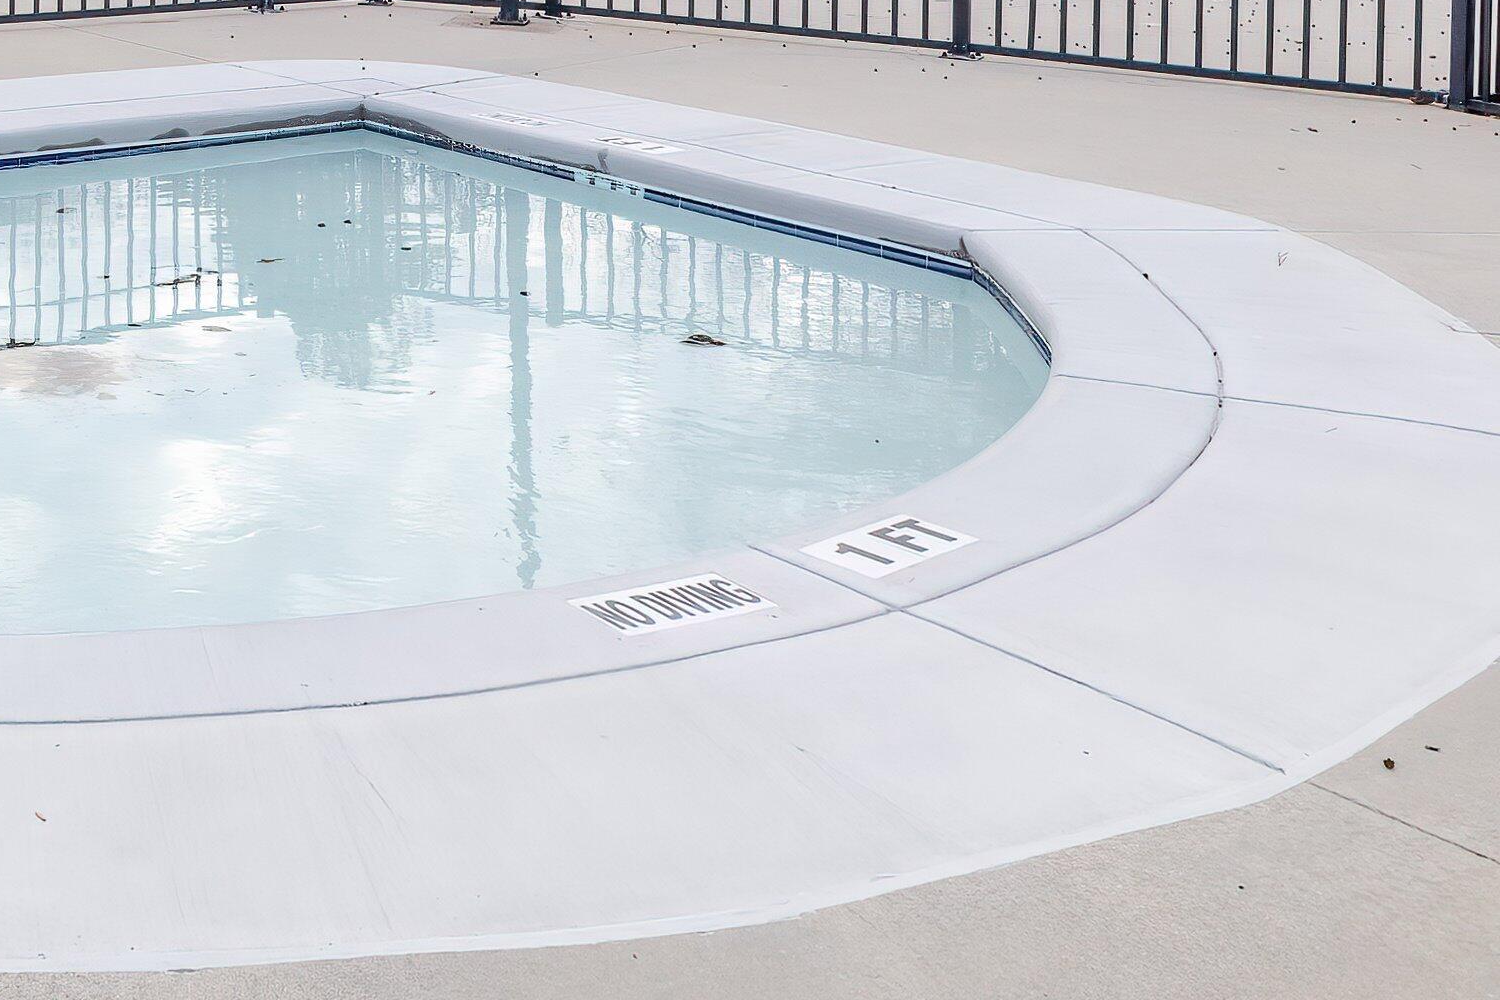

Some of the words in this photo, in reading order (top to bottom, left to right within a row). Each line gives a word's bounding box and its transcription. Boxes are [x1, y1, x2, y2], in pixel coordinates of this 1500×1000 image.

[835, 542, 895, 565] 1
[867, 518, 958, 553] FT
[580, 600, 656, 630] NO
[629, 579, 761, 621] DIVING
